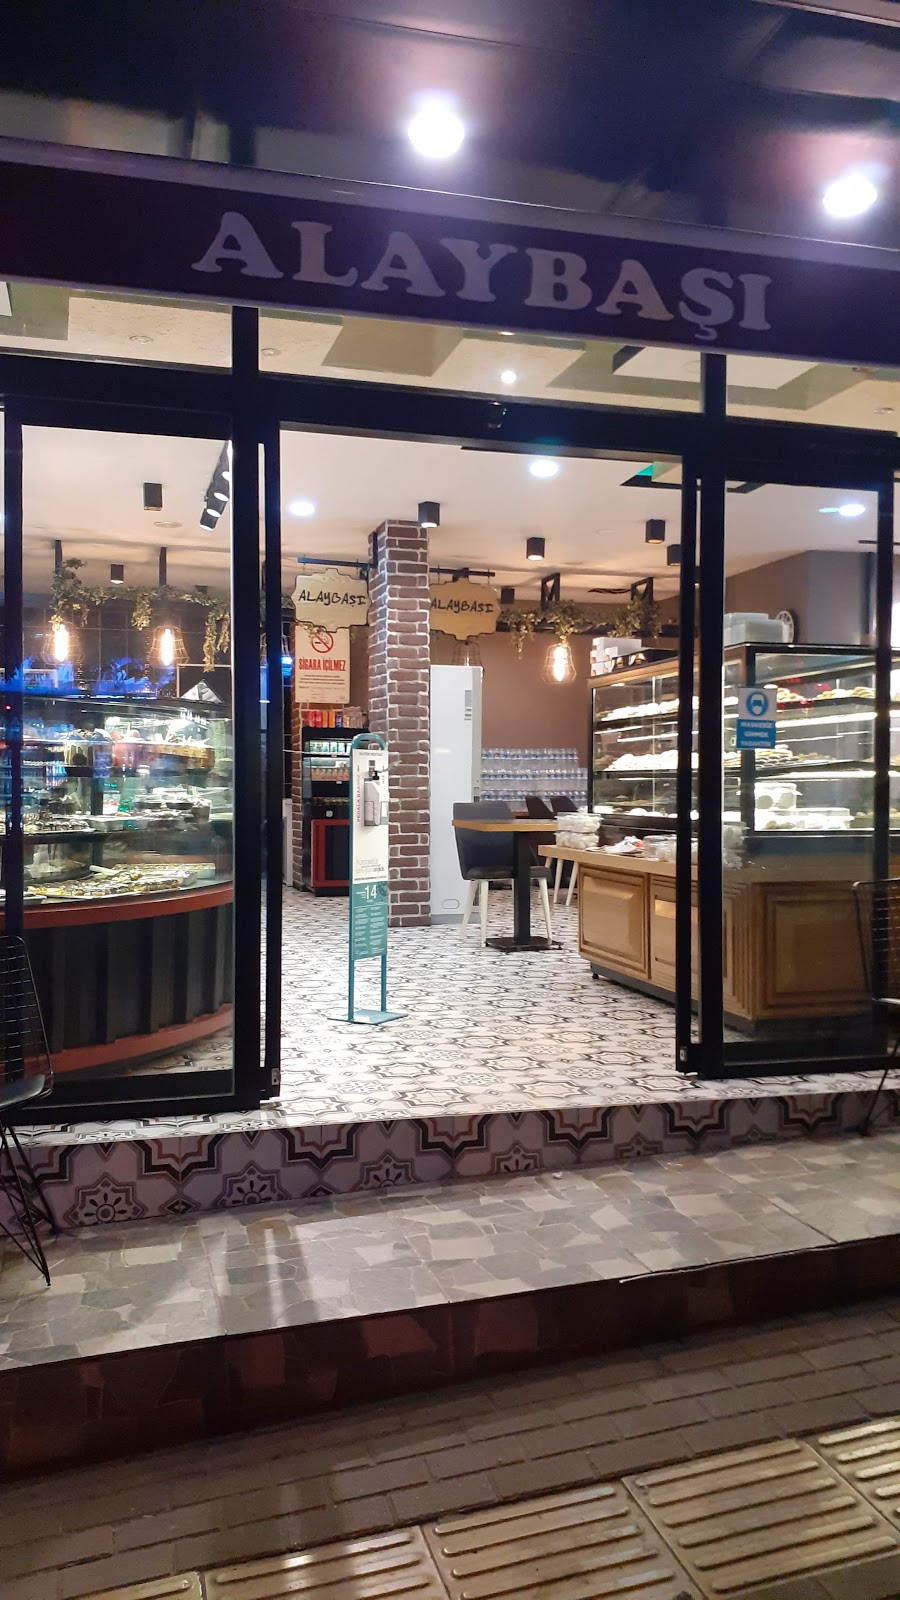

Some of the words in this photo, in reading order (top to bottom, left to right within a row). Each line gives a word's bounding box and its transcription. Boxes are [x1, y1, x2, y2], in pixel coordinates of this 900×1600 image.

[190, 211, 772, 341] ALAYBAŞI
[298, 589, 367, 608] ALAYBAŞI
[298, 656, 321, 671] SİGARA
[322, 657, 347, 672] İÇİLMEZ
[364, 884, 378, 900] 14
